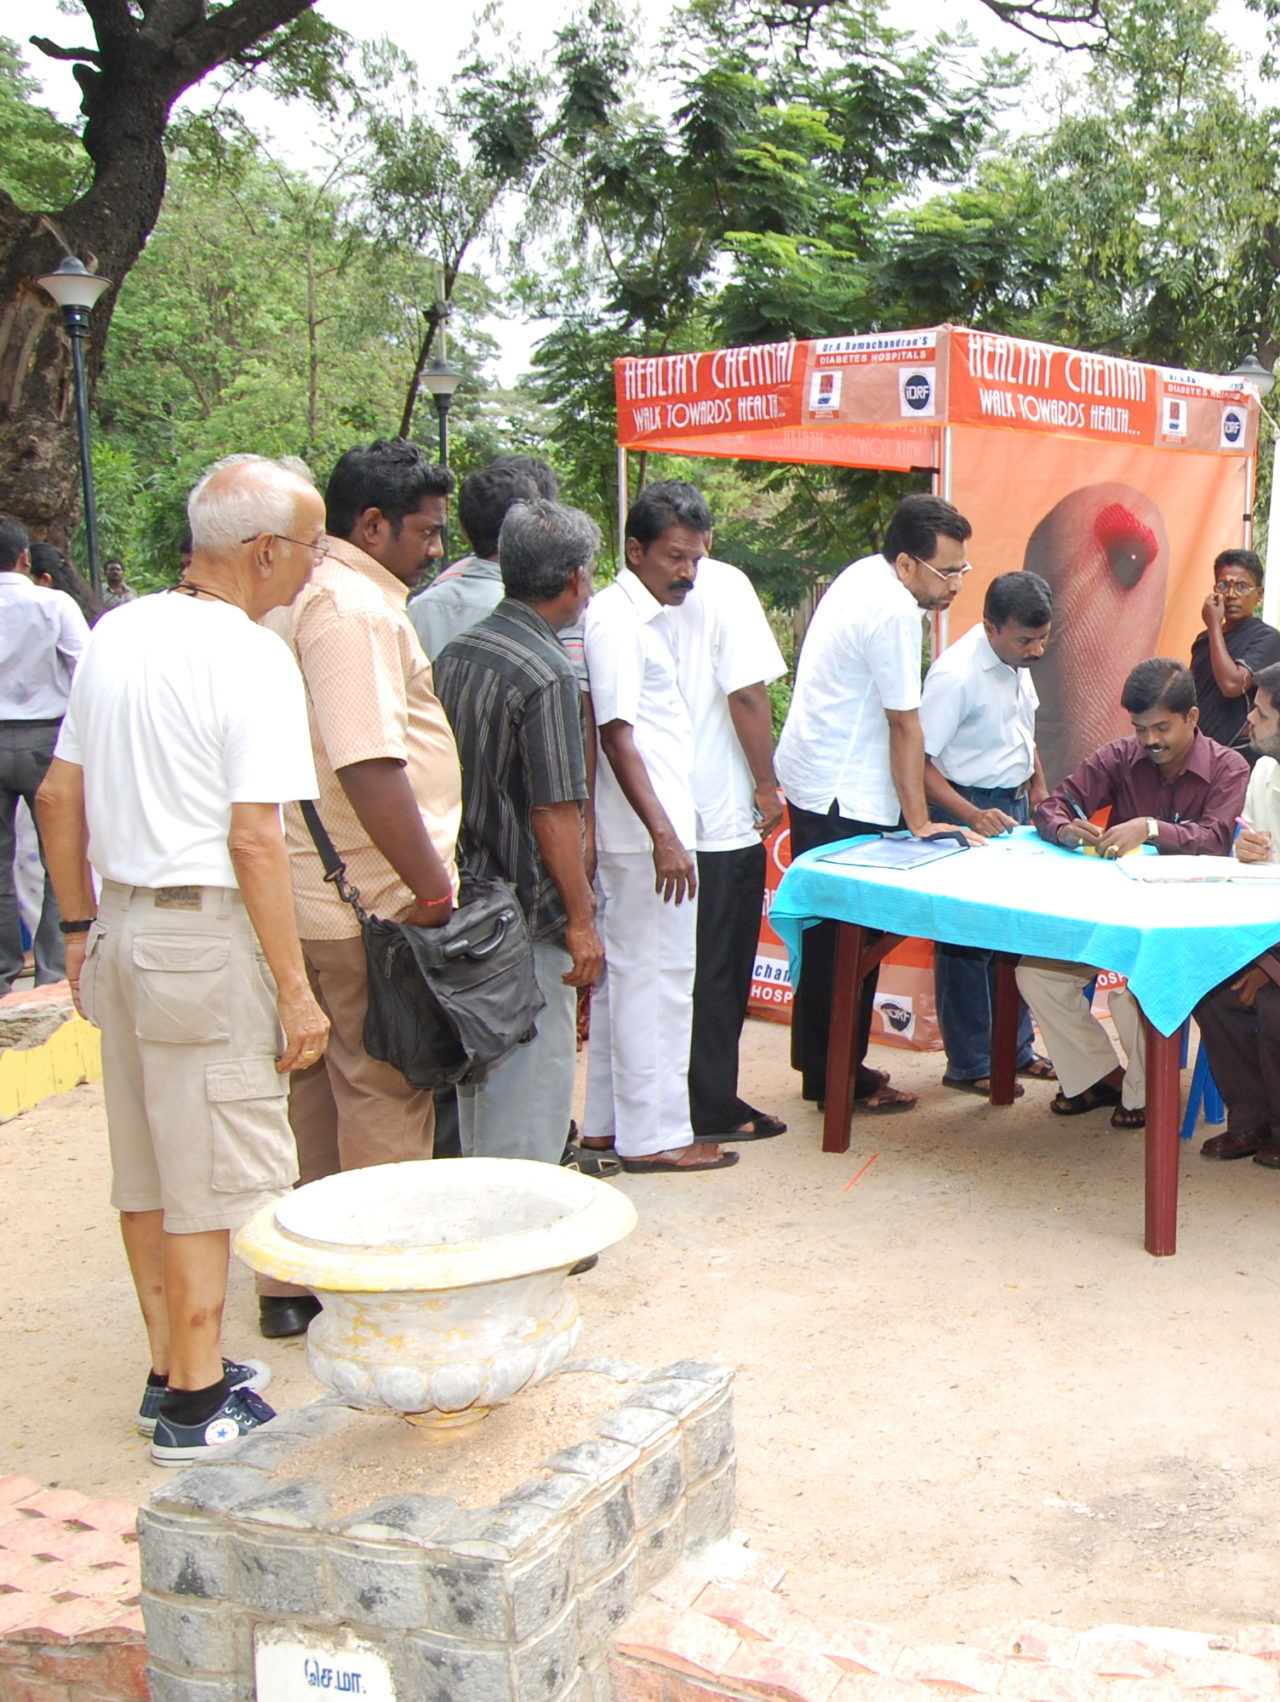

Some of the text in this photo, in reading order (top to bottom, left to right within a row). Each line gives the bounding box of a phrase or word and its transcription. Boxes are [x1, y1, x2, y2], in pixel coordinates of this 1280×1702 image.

[625, 341, 797, 400] HEALTHY CHENNAI
[820, 350, 926, 365] DIABETES HOSPITALS
[968, 333, 1147, 403] HEALTHY CHENNAI
[632, 405, 662, 433] WALK
[666, 399, 732, 428] TOWARDS
[979, 387, 1141, 436] WALK TOWARDS HEALTH...
